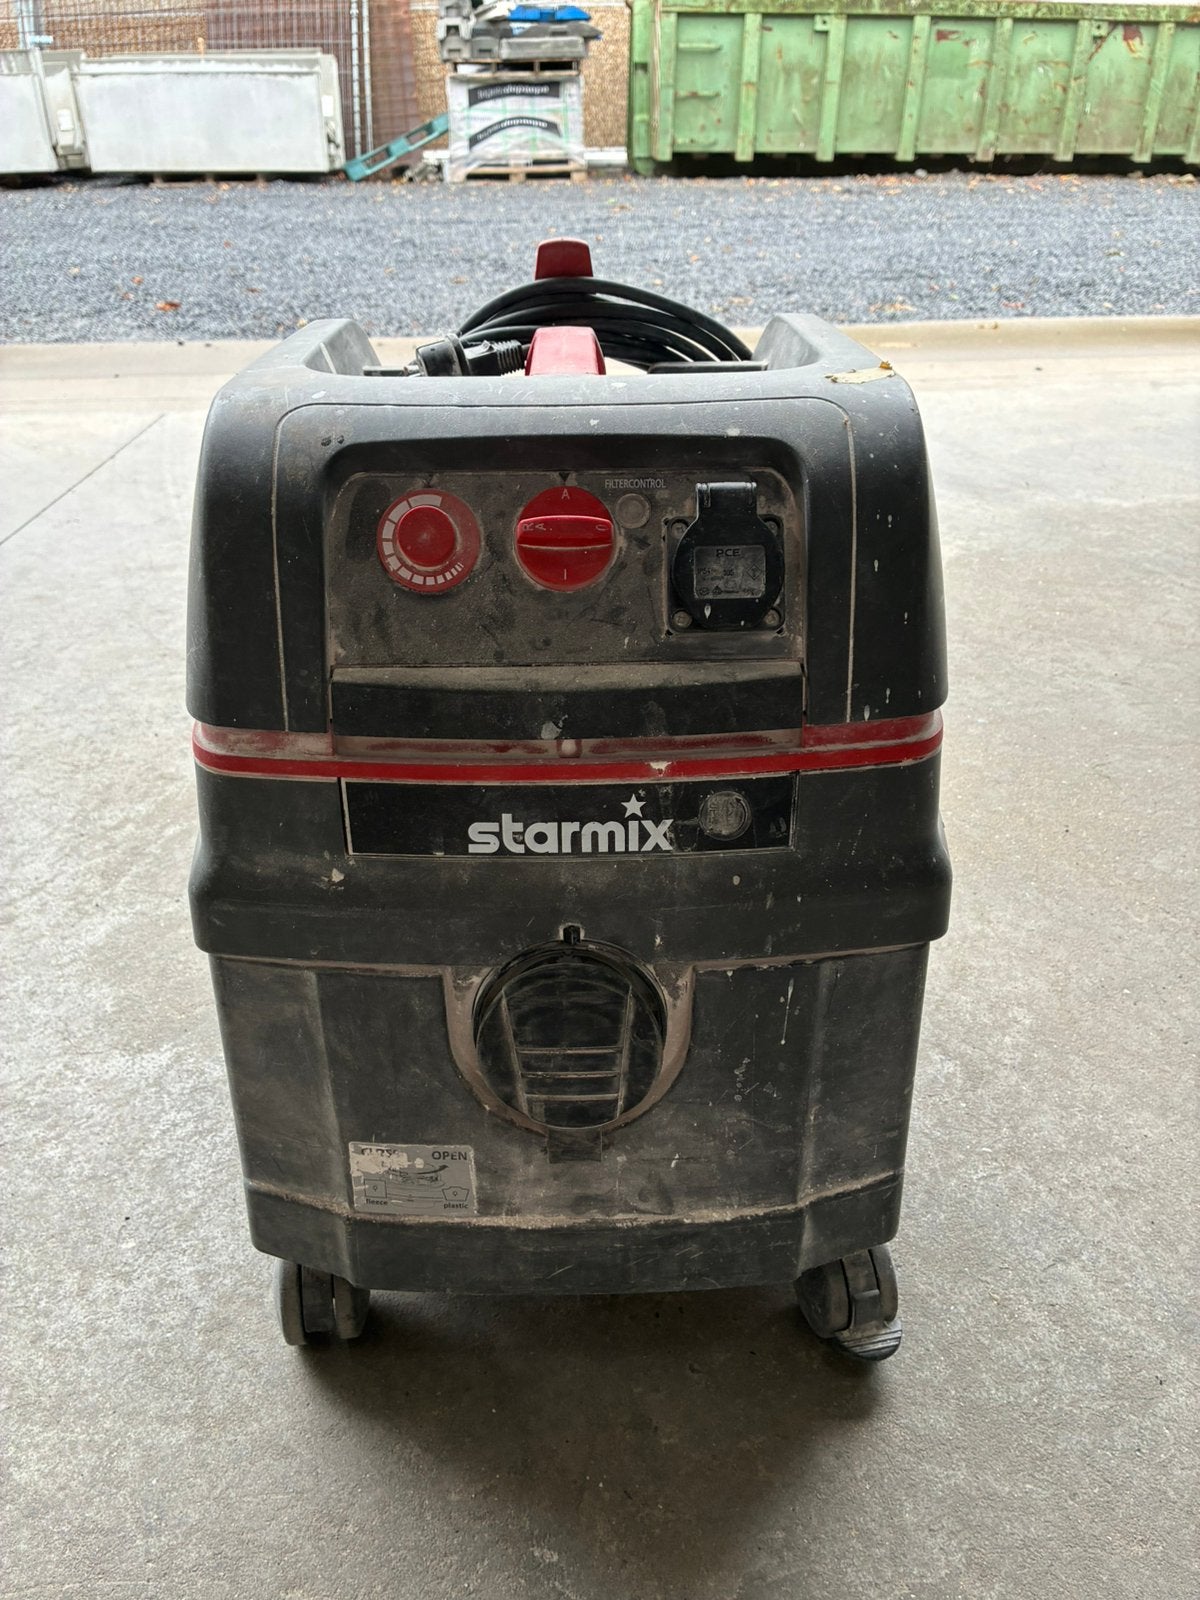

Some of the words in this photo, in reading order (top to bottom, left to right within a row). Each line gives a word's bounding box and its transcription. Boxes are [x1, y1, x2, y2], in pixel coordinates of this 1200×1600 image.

[604, 478, 667, 489] FILTERCONTROL
[561, 488, 570, 500] A
[468, 793, 674, 854] starmix
[431, 1150, 468, 1162] OPEN
[443, 1202, 469, 1210] plastic
